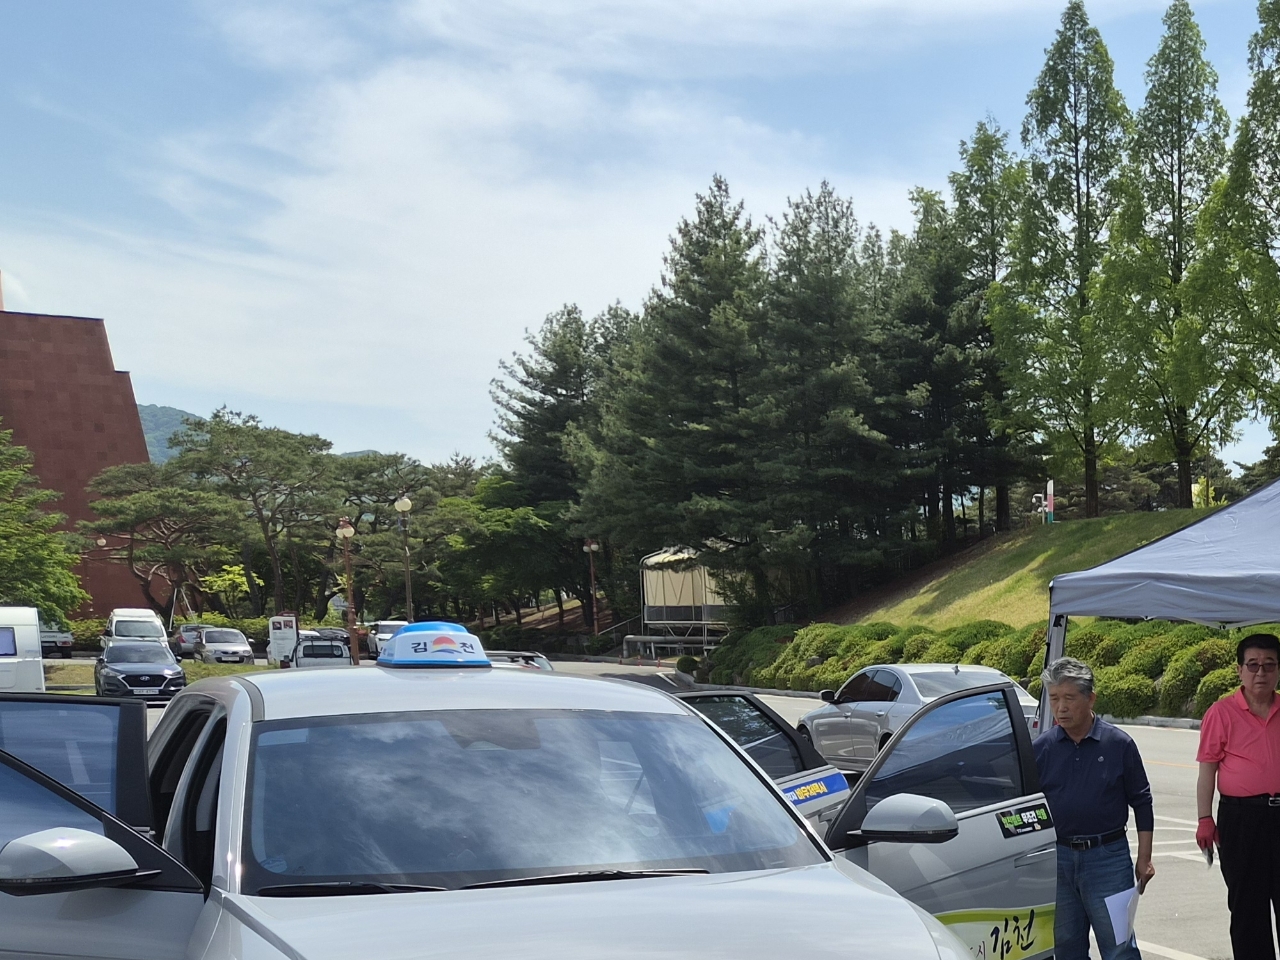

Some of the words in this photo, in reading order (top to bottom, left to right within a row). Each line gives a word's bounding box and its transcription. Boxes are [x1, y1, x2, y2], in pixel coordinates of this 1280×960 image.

[411, 641, 427, 653] 김
[459, 641, 475, 654] 천
[990, 909, 1037, 960] 김천
